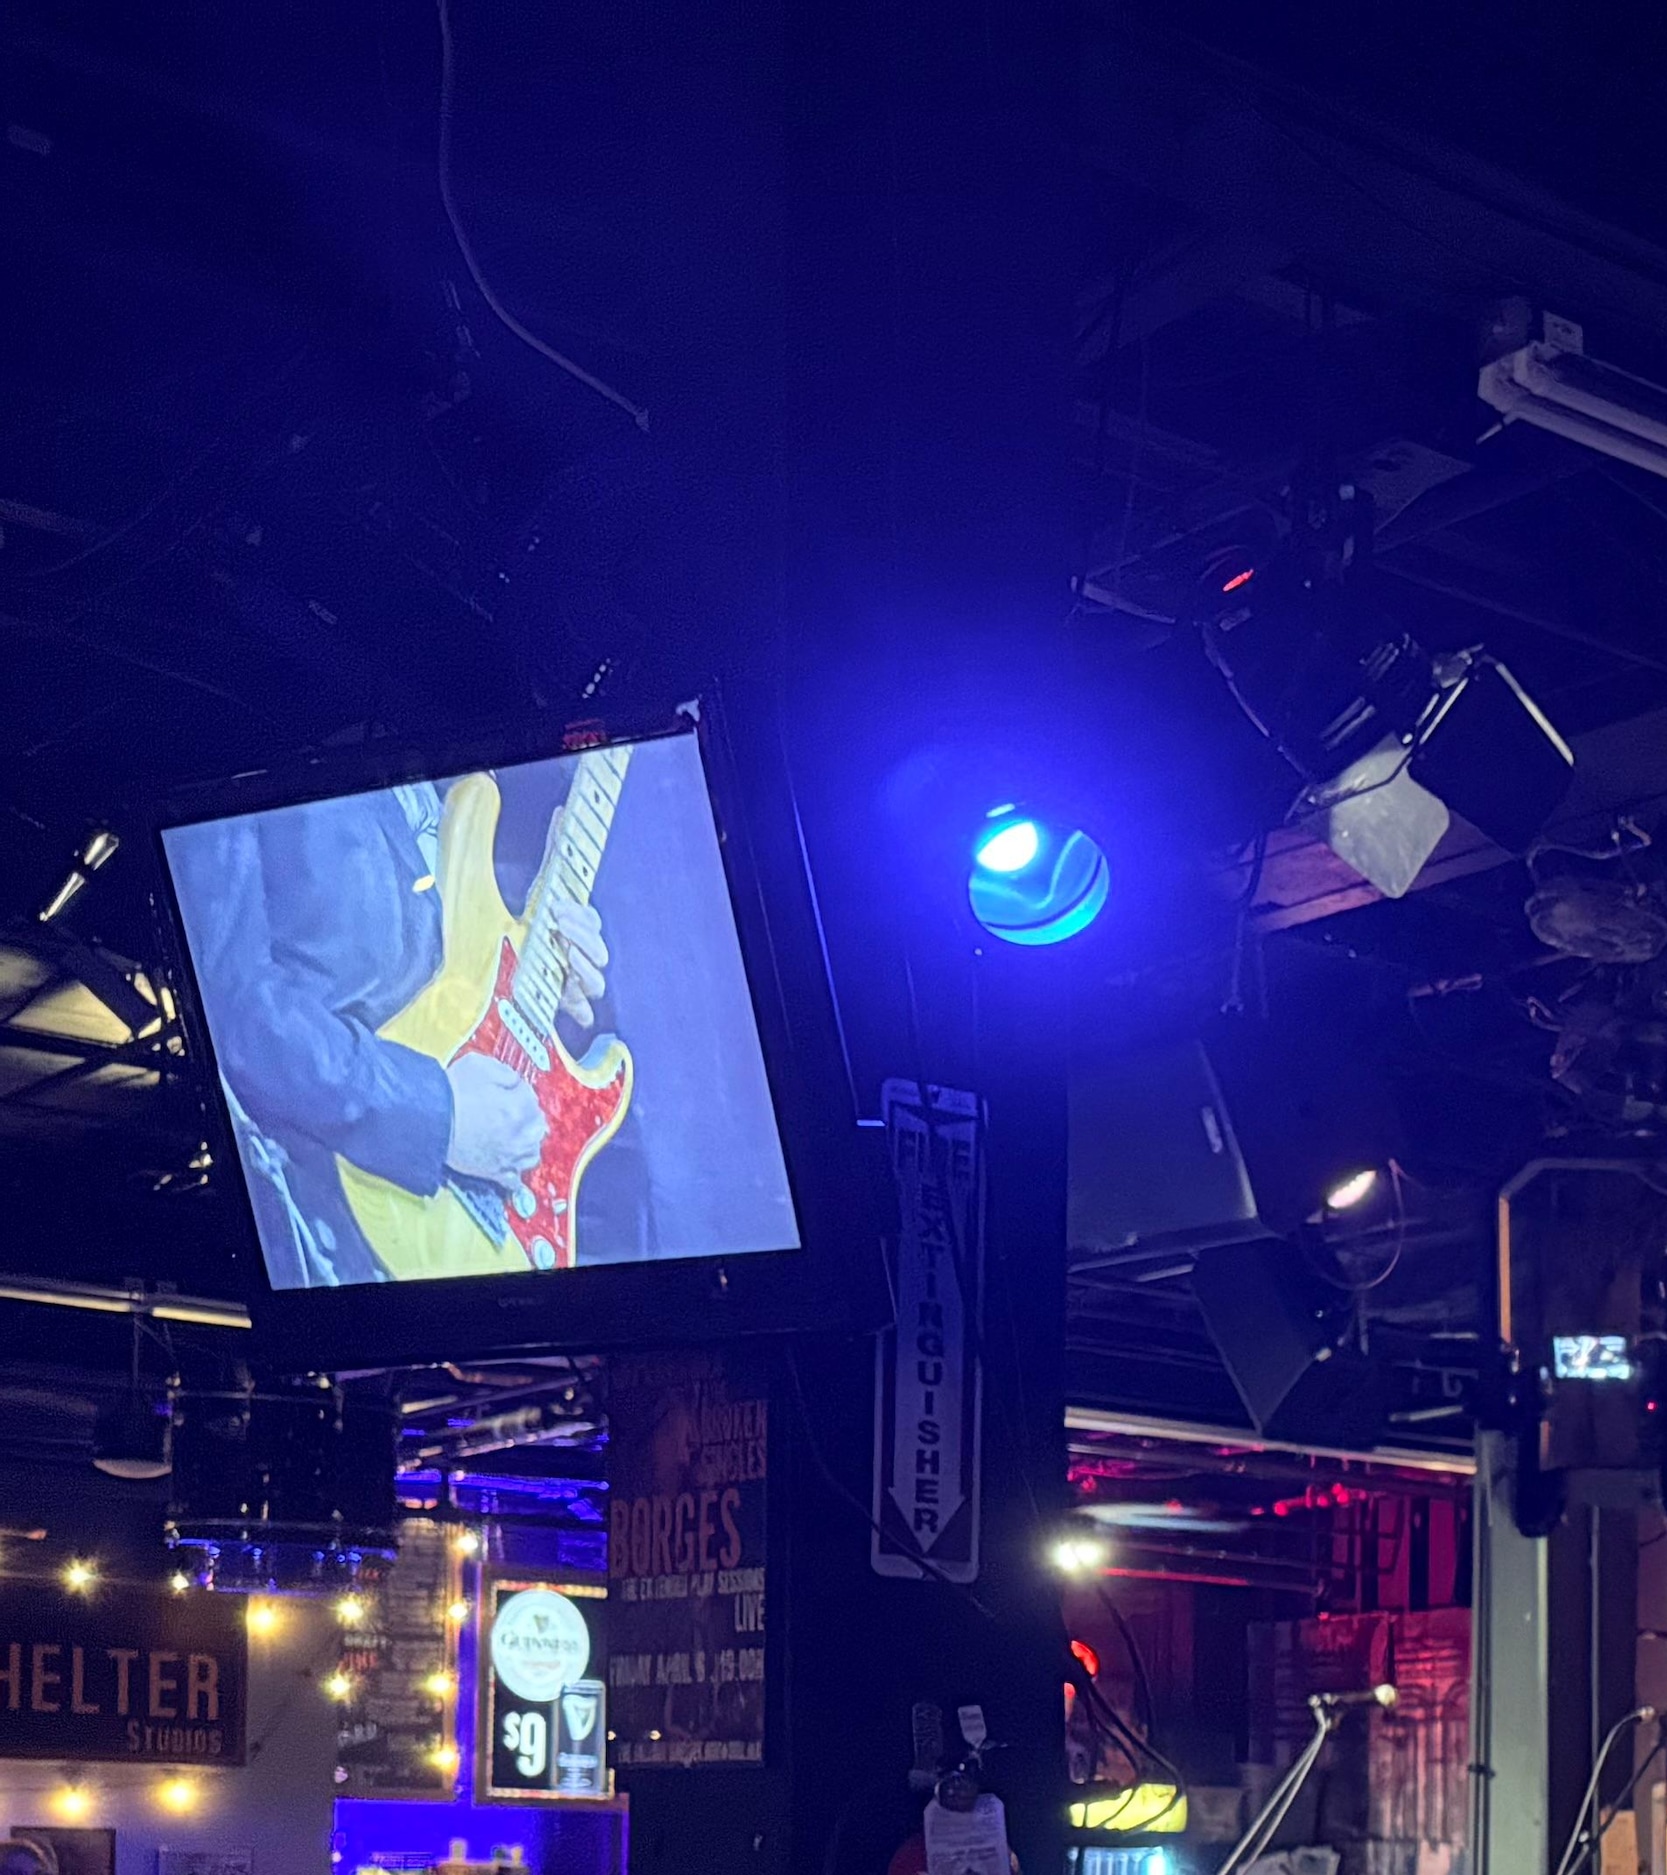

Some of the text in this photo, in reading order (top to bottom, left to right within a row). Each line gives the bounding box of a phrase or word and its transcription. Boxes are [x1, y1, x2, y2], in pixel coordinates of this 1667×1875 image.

[897, 1129, 971, 1180] FIE
[913, 1183, 951, 1533] EXTINGUISHER
[609, 1487, 742, 1578] BORGES
[734, 1592, 766, 1632] LIVE
[126, 1717, 223, 1755] STUDIOS
[503, 1711, 547, 1777] $9
